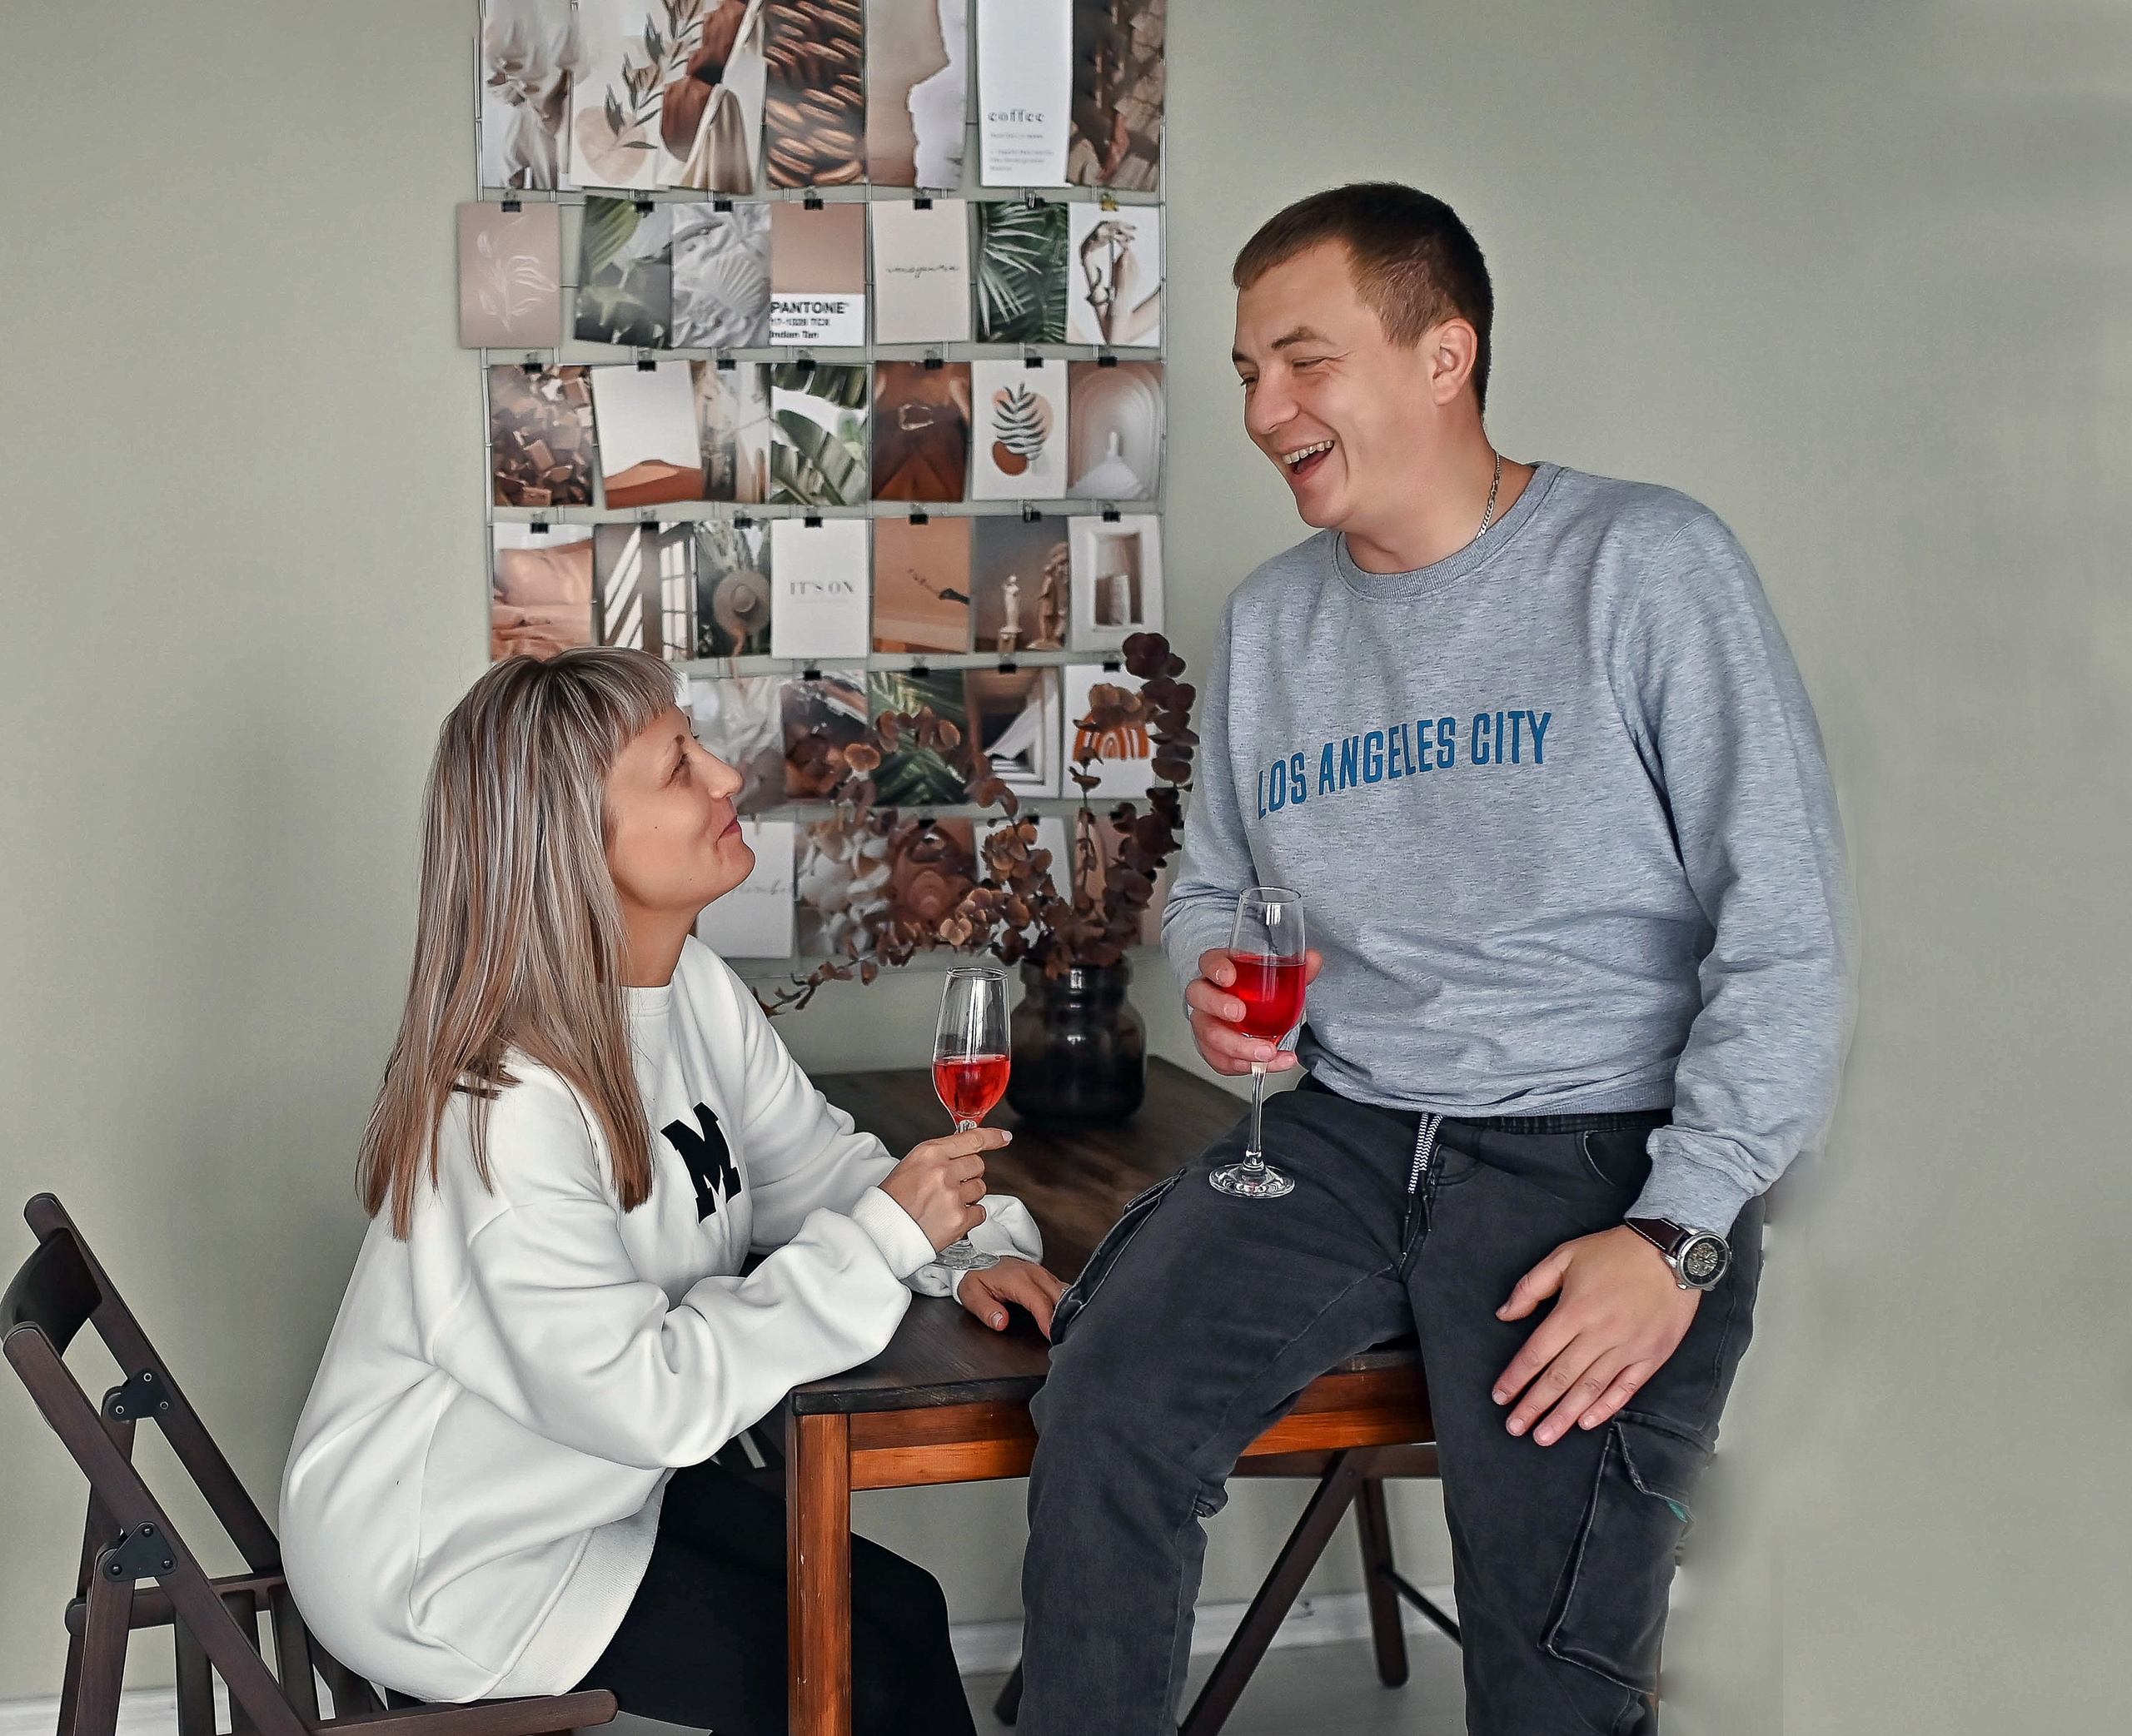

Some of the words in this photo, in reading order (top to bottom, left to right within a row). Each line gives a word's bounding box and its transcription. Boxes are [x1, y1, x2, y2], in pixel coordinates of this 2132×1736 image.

[770, 301, 846, 314] PANTONE
[1258, 751, 1308, 821] LOS
[1318, 716, 1457, 796] ANGELES
[1470, 709, 1552, 766] CITY
